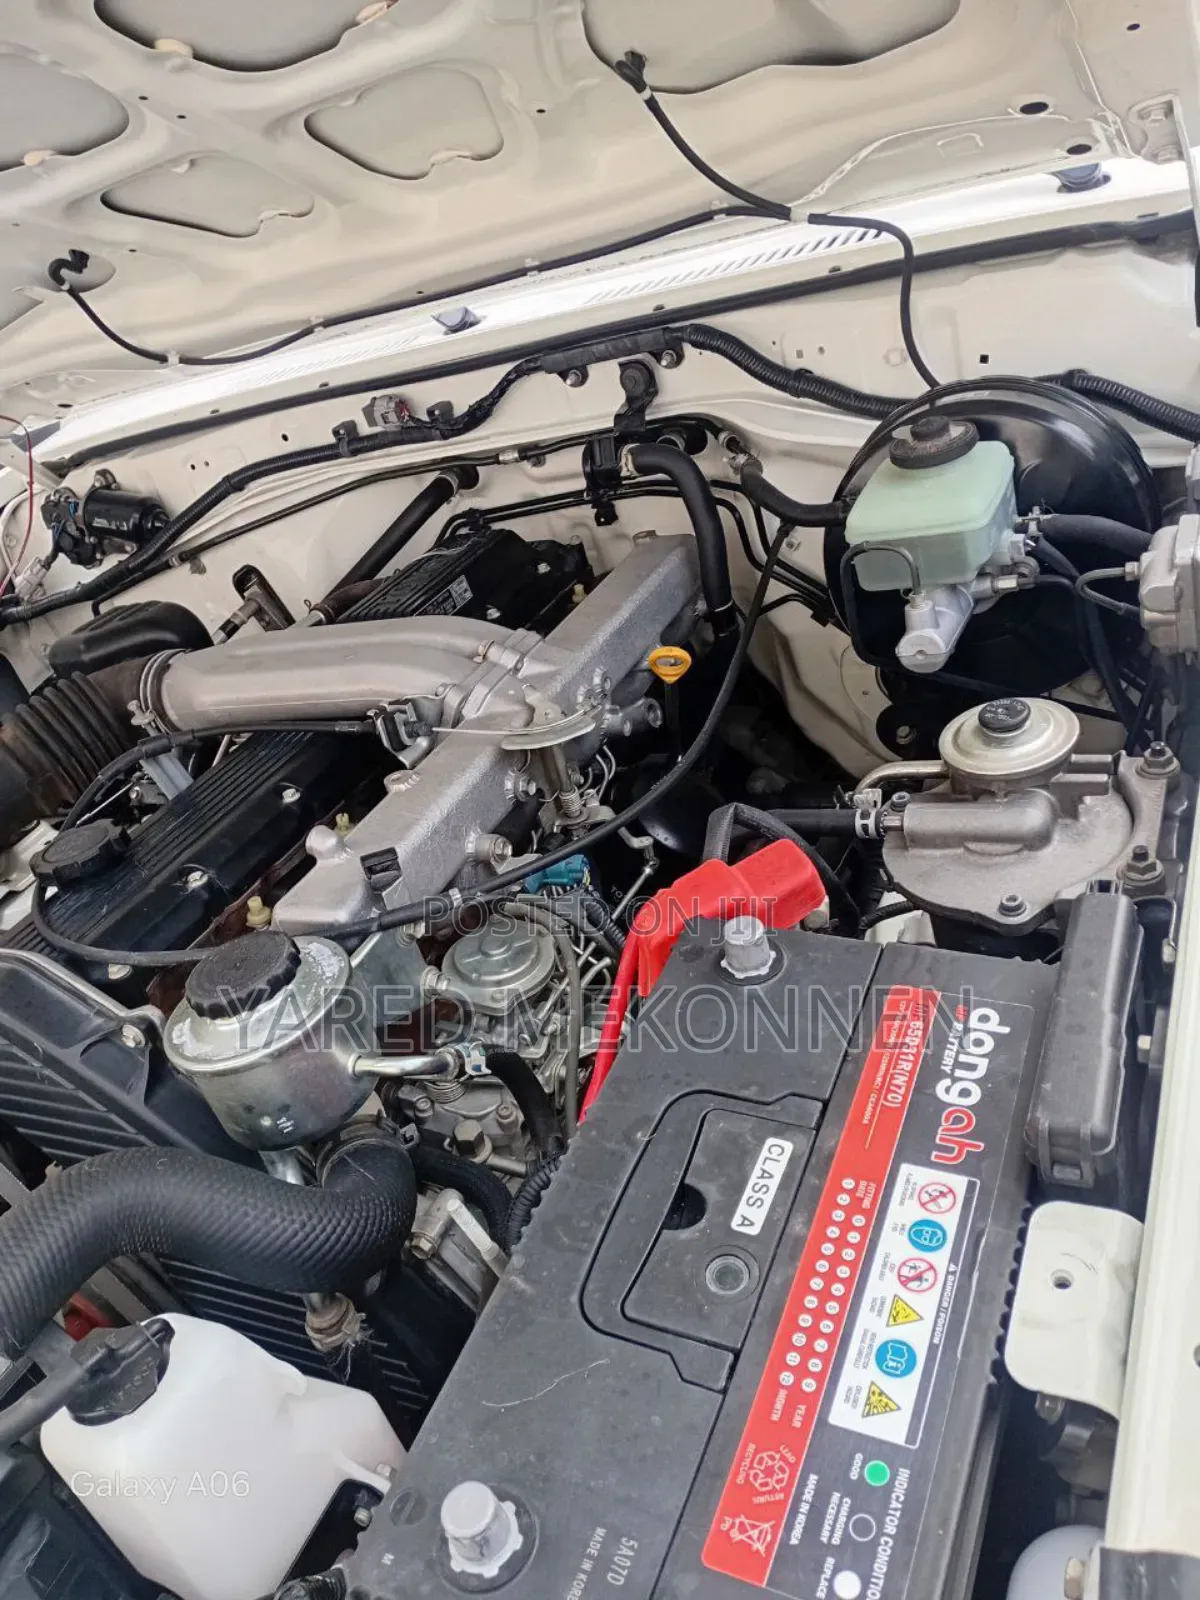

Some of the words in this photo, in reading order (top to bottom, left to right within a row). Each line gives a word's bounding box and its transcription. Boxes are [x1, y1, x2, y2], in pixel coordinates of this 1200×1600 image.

[941, 1021, 963, 1075] BATTERY
[930, 1007, 1010, 1164] dongah
[746, 1144, 785, 1209] CLASS
[736, 1214, 755, 1228] A
[941, 1274, 955, 1308] DANGER
[933, 1312, 946, 1345] POISON
[770, 1388, 788, 1422] MONTH
[791, 1404, 807, 1429] YEAR
[736, 1442, 757, 1485] RECYCLING
[849, 1452, 863, 1480] GOOD
[802, 1473, 819, 1503] MADE
[883, 1467, 910, 1536] INDICATOR
[720, 1516, 732, 1531] Pb
[799, 1502, 811, 1514] IN
[820, 1492, 841, 1544] NECESSARY
[831, 1497, 851, 1545] CHARGING
[586, 1526, 607, 1557] MADE
[789, 1513, 808, 1545] KOREA
[580, 1558, 594, 1572] IN
[606, 1536, 639, 1586] 5A07D
[816, 1556, 836, 1600] REPLACE
[866, 1536, 894, 1600] CONDITIO
